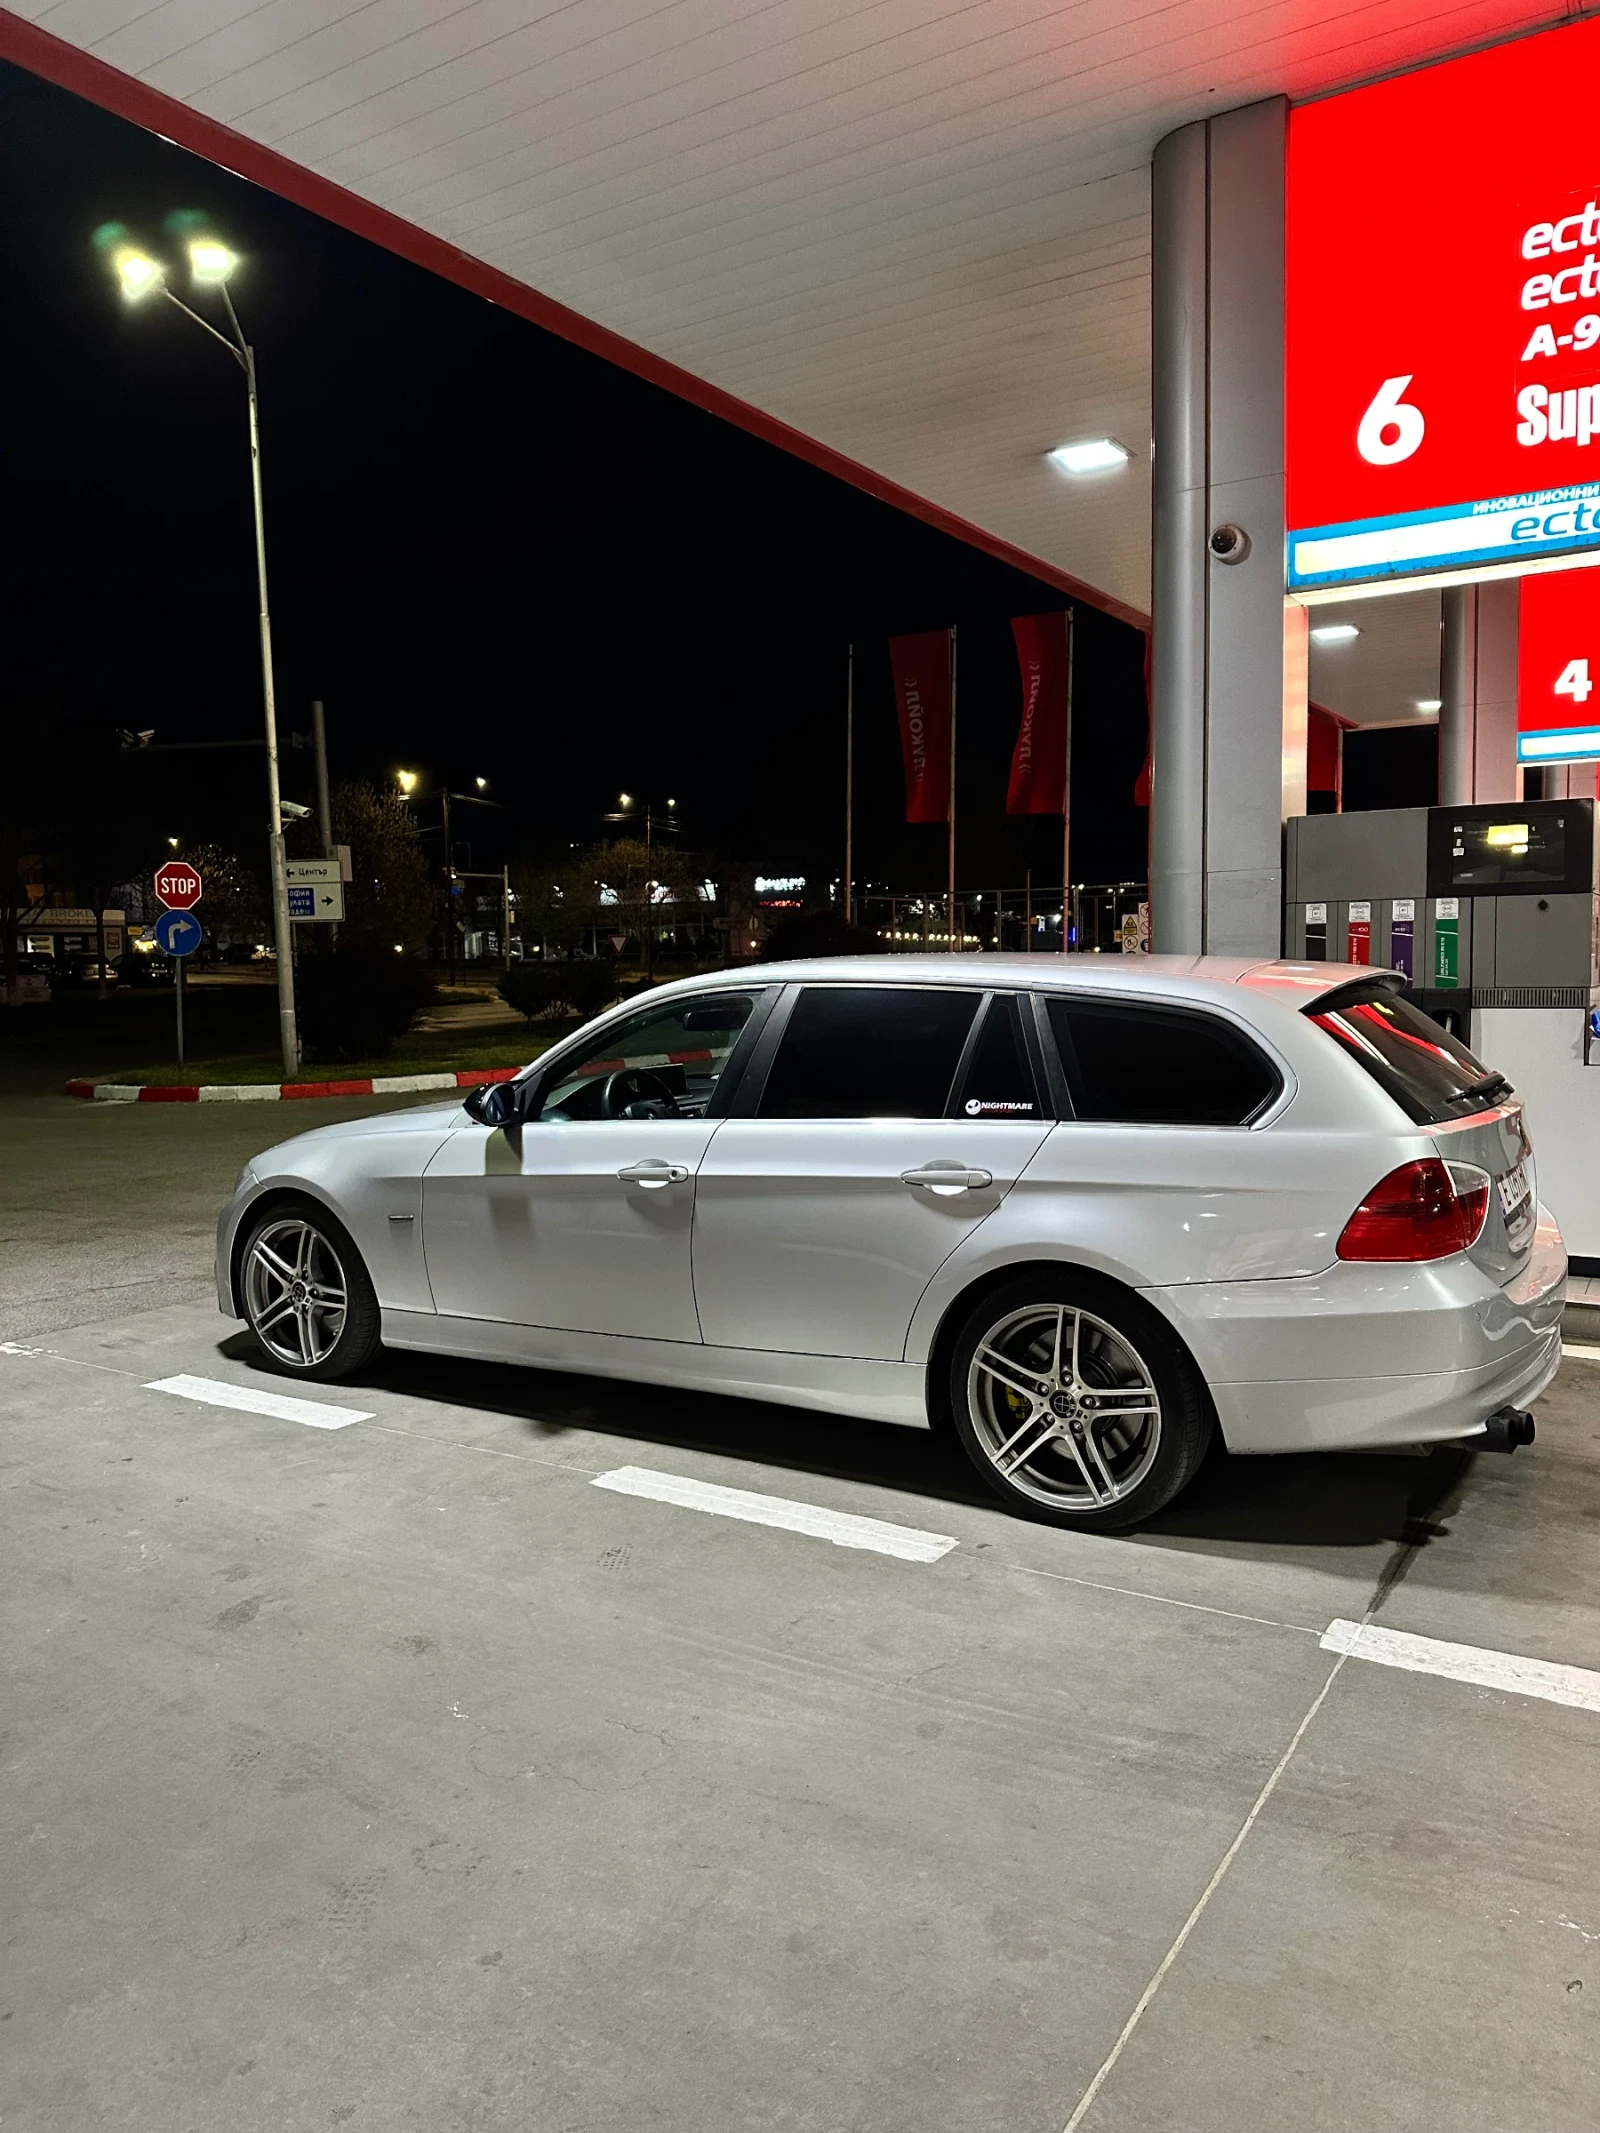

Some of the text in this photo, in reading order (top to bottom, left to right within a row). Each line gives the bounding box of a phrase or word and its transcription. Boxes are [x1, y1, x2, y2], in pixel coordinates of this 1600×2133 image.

[1522, 201, 1600, 260] ect
[1521, 253, 1600, 310] ect
[1520, 314, 1600, 362] A-9
[1357, 374, 1425, 465] 6
[1472, 484, 1600, 514] ИНОВАЦИОННИ
[1554, 658, 1593, 702] 4
[298, 867, 328, 877] Център
[161, 877, 196, 895] STOP
[289, 889, 310, 897] офия
[49, 909, 93, 918] BROKE
[289, 899, 310, 908] улата
[981, 1102, 1033, 1110] NIGHTMARE
